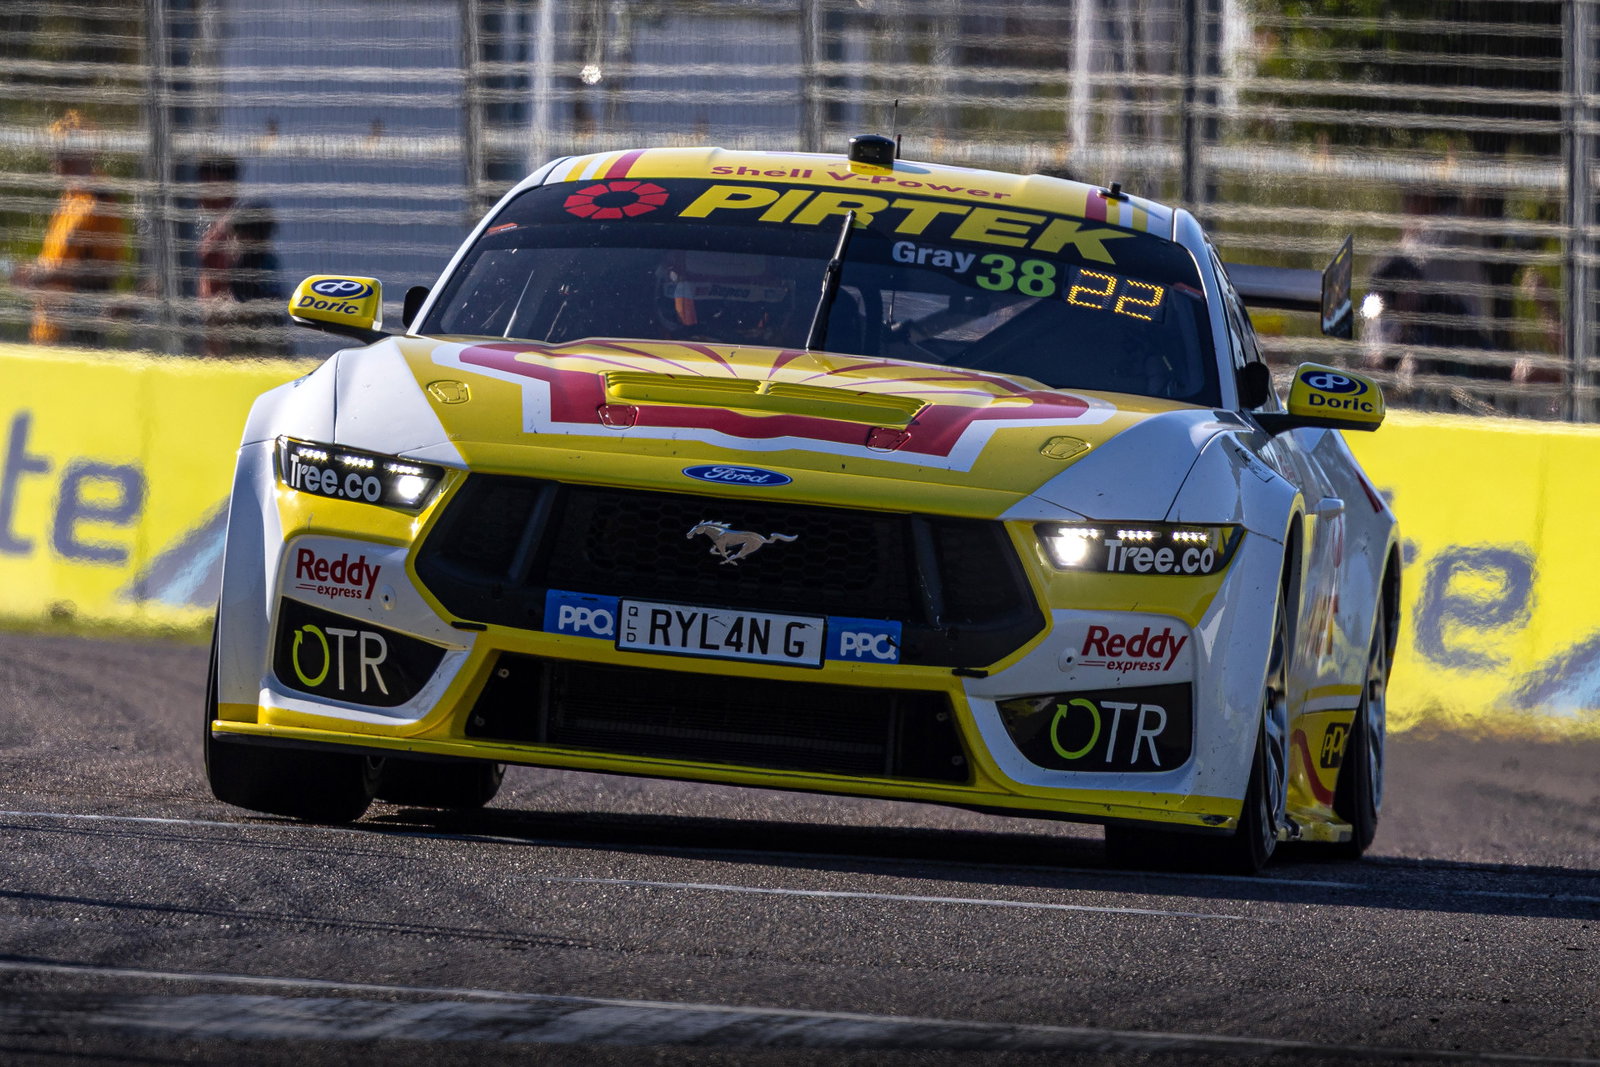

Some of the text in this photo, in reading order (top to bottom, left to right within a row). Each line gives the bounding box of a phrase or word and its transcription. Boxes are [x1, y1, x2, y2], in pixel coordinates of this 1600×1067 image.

[711, 166, 1011, 199] Shell V-Power
[678, 185, 1137, 265] PIRTEK
[892, 240, 1056, 298] Gray 38
[297, 295, 359, 314] Doric
[1067, 268, 1165, 320] 22
[1309, 393, 1374, 412] Doric
[290, 454, 382, 502] Tree.co
[704, 466, 770, 483] Ford
[296, 548, 381, 600] Reddy
[1105, 539, 1215, 573] Tree.co
[317, 584, 362, 599] express
[558, 605, 615, 636] PPQ
[649, 608, 805, 658] RYL4N G
[292, 624, 389, 695] OTR
[840, 631, 897, 660] PPQ
[1081, 625, 1188, 671] Reddy
[1106, 660, 1162, 673] express
[1050, 698, 1167, 766] OTR
